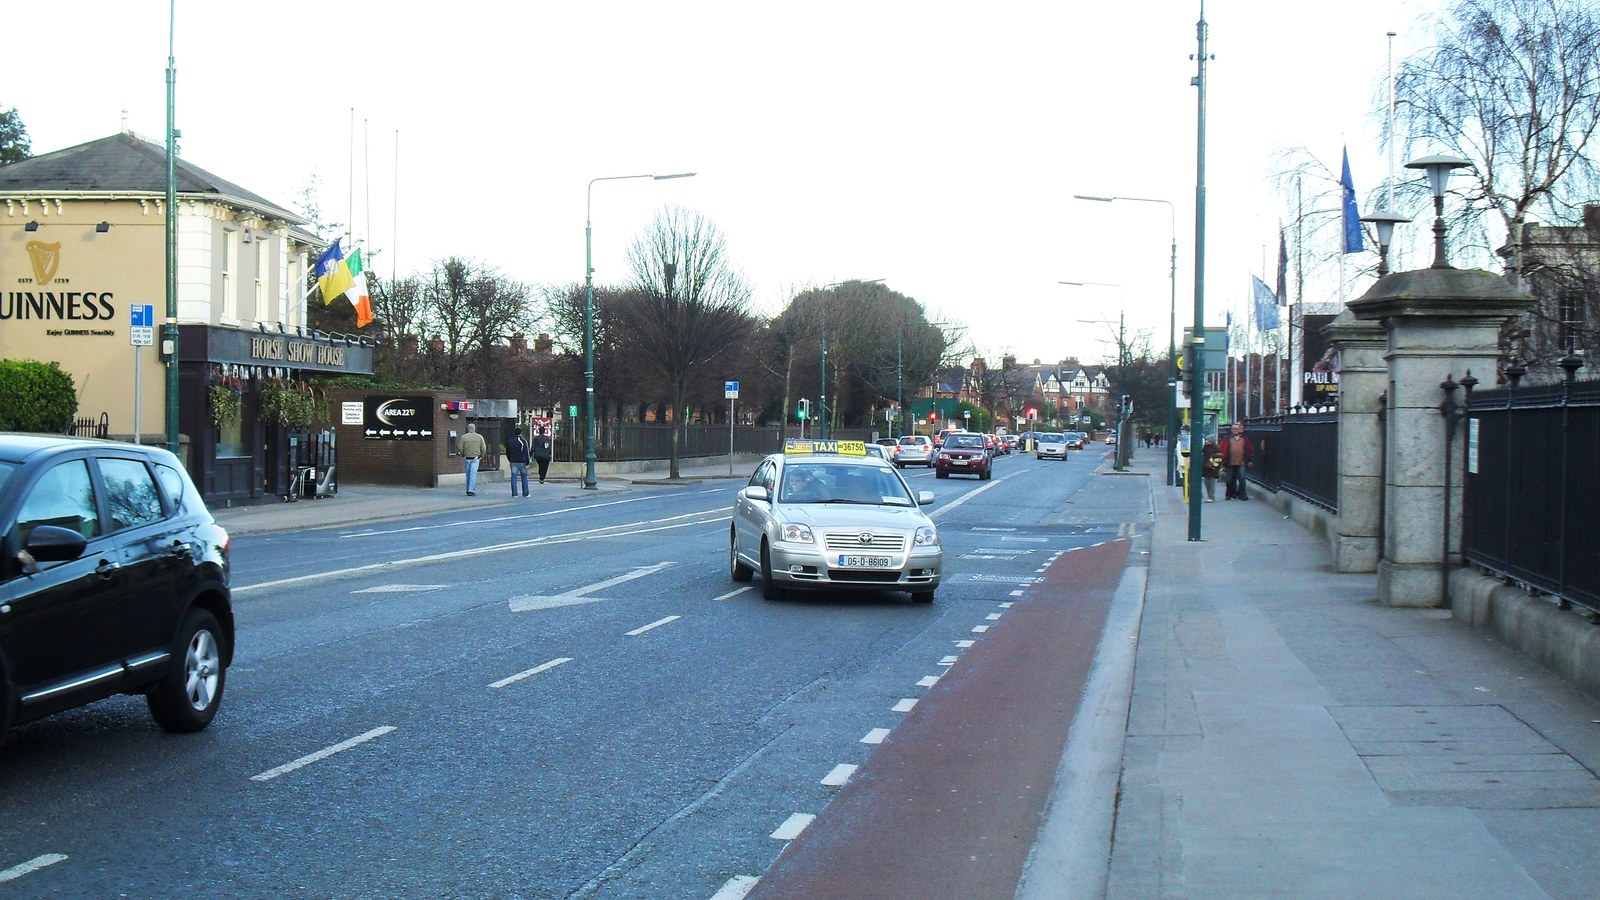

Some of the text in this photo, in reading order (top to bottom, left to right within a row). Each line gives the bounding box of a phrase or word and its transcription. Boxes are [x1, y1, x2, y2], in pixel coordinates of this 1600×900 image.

[64, 328, 90, 336] GUINNESS
[252, 337, 344, 365] HORSE SHOW HOUSE
[1304, 371, 1330, 384] PAUL
[384, 408, 410, 416] AREA 22
[813, 441, 838, 452] TAXI
[843, 442, 864, 452] 36750
